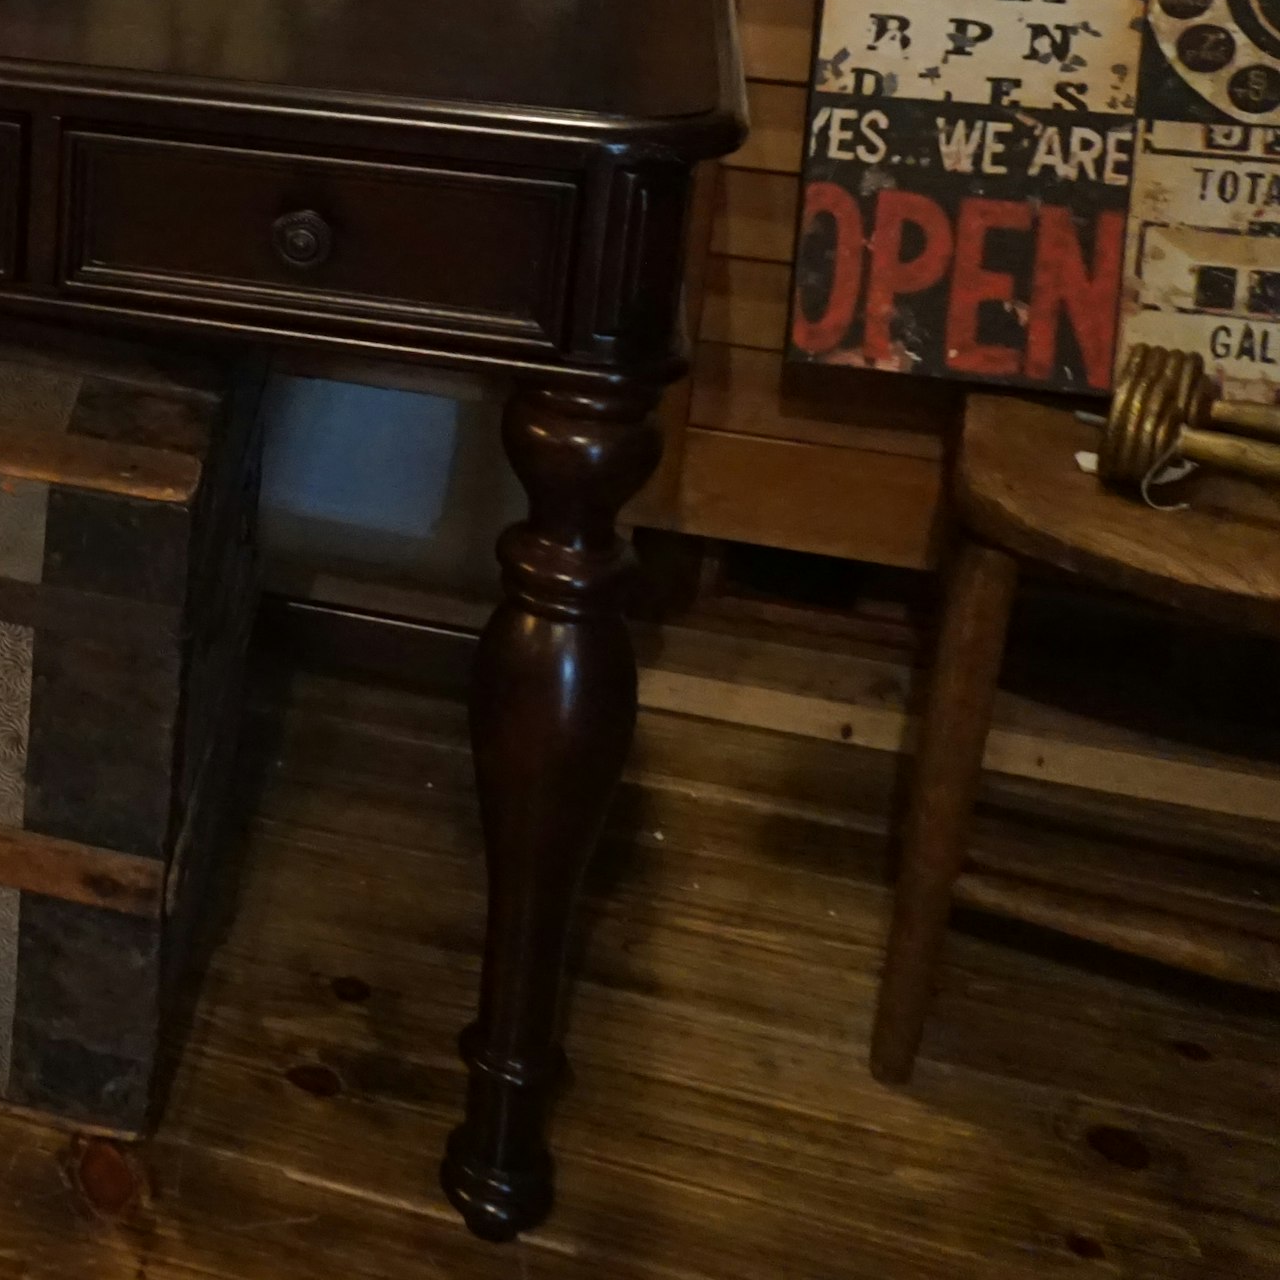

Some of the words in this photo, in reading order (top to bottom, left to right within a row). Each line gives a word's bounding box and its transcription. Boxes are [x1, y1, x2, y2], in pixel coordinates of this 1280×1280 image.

[945, 18, 994, 56] P
[1022, 23, 1074, 63] N
[936, 117, 1013, 175] WE
[1028, 124, 1133, 186] ARE
[791, 181, 1124, 391] OPEN
